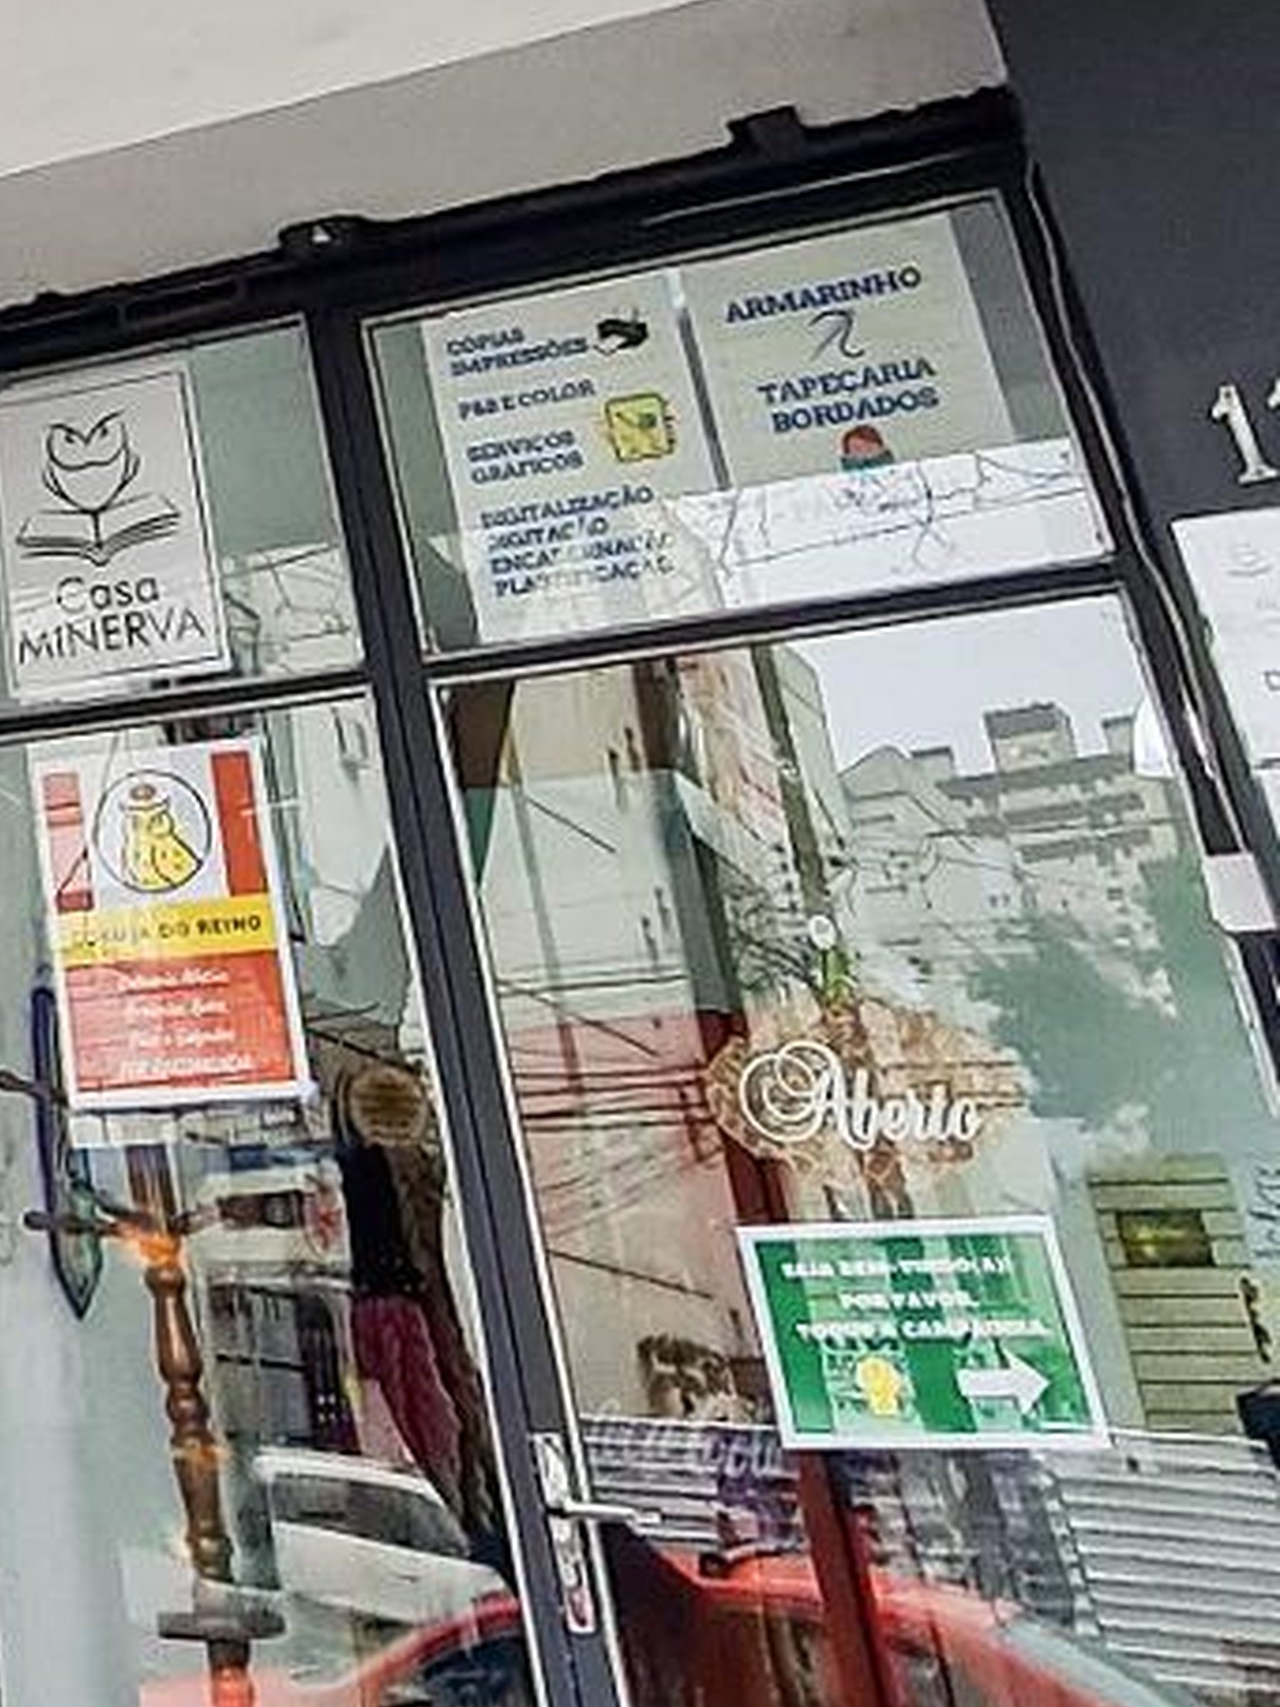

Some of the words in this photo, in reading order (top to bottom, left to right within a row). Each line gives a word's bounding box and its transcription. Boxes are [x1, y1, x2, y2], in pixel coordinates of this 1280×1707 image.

[724, 265, 923, 325] ARMARINHO
[517, 378, 597, 406] COLOR
[771, 386, 941, 435] BORDADOS
[56, 575, 160, 614] Casa
[17, 607, 207, 665] MINERVA
[195, 913, 264, 937] REINO
[739, 1039, 983, 1150] Aberto
